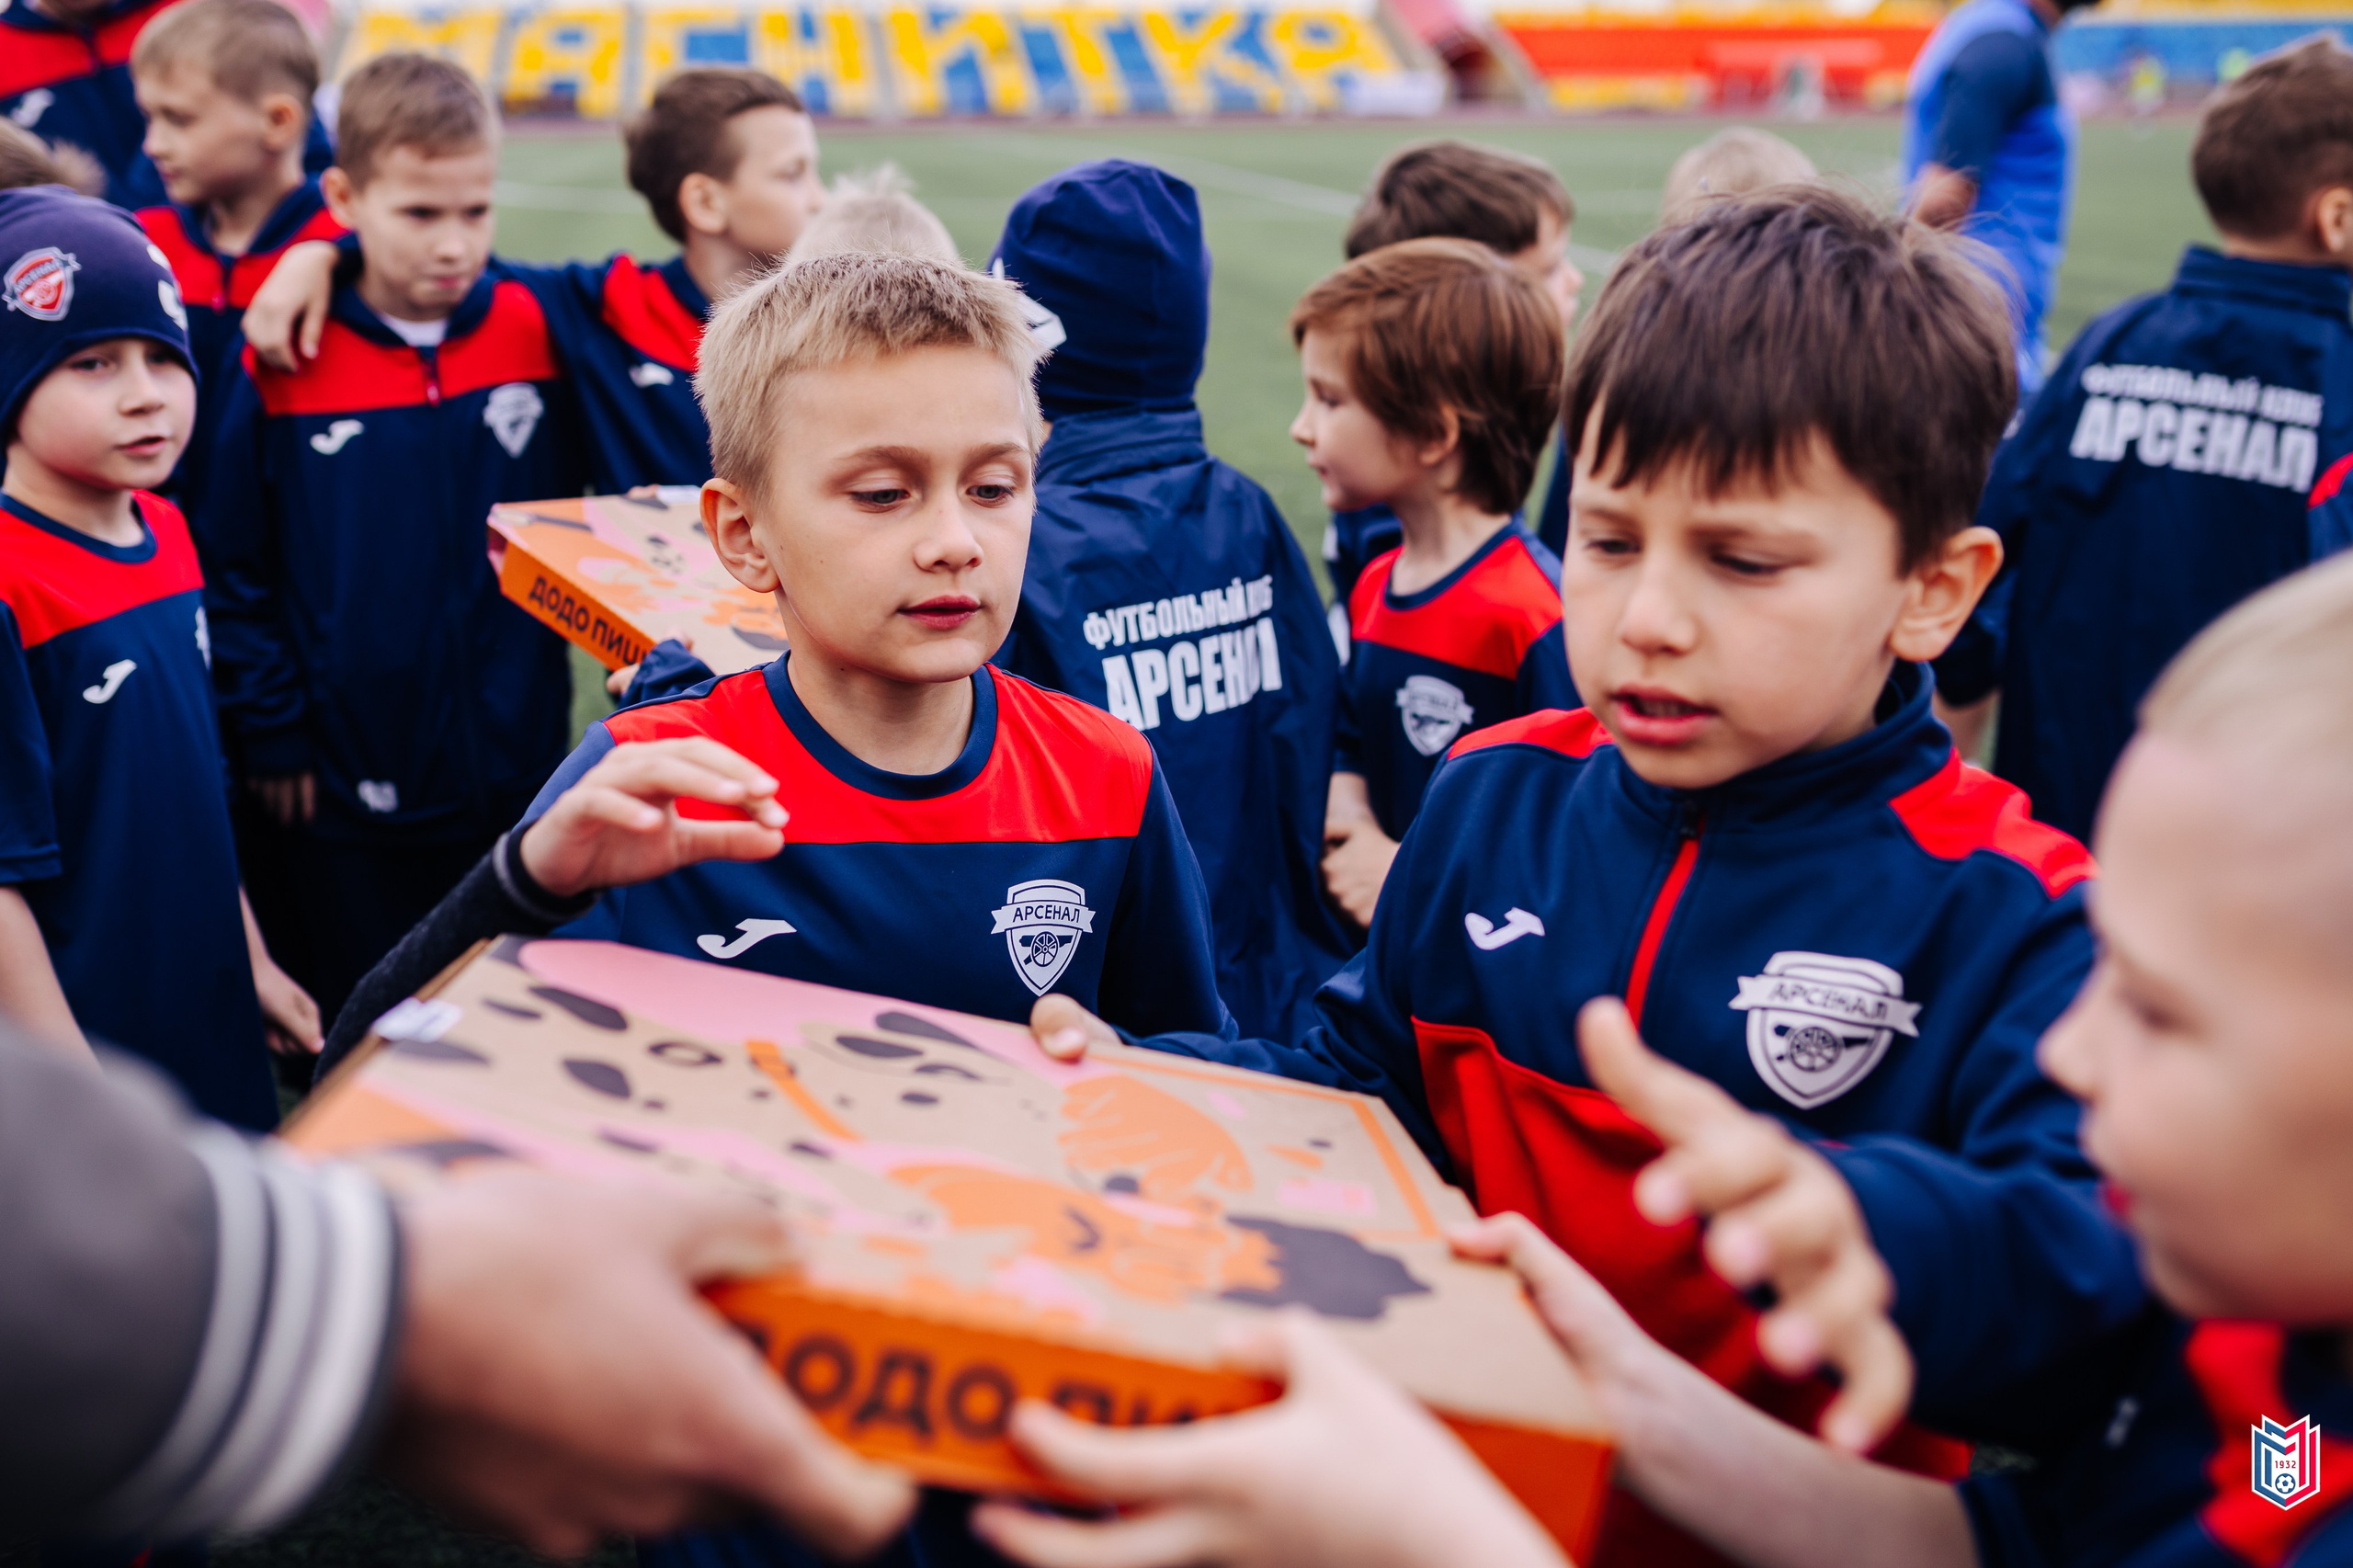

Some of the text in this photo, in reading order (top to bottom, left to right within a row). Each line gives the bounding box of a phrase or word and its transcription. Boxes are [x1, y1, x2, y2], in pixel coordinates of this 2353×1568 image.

[2069, 396, 2319, 494] АРСЕНАЛ
[529, 574, 590, 633] ДОДО
[1083, 576, 1248, 651] ФУТБОЛЬНЫЙ
[1012, 904, 1080, 924] АРСЕНАЛ
[1768, 981, 1888, 1020] АРСЕНАЛ
